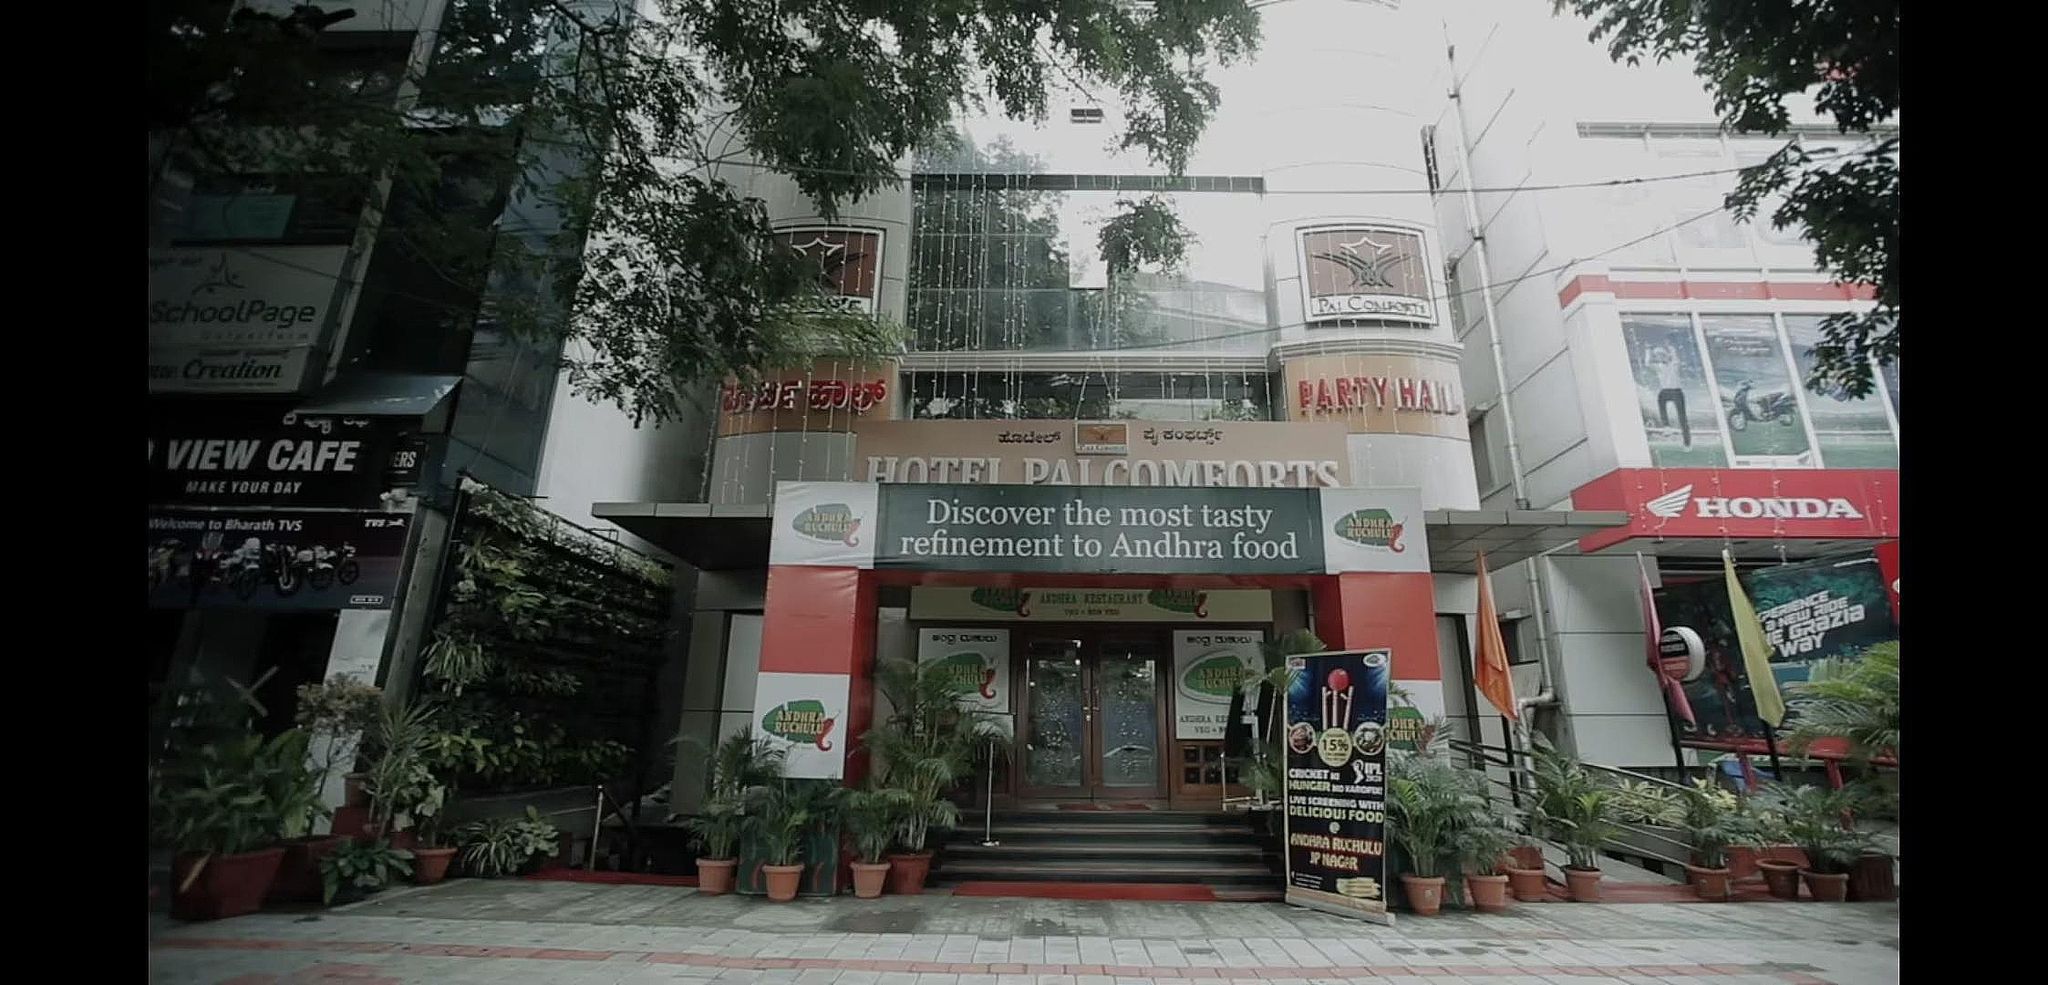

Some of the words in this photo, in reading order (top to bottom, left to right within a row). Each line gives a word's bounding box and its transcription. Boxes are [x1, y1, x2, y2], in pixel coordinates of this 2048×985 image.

[151, 299, 316, 329] SchoolPage
[183, 358, 282, 379] Creation
[1298, 376, 1389, 413] PARTY
[1395, 378, 1461, 415] HALL
[166, 438, 263, 471] VIEW
[266, 438, 361, 472] CAFE
[1104, 458, 1342, 488] COMFORTS
[184, 481, 226, 494] MAKE
[231, 481, 270, 494] YOUR
[273, 482, 303, 494] DAY
[926, 499, 1056, 526] Discover
[1063, 500, 1111, 527] the
[1120, 504, 1193, 528] most
[1200, 503, 1273, 535] tasty
[1693, 497, 1863, 519] HONDA
[149, 517, 206, 531] Welcome
[208, 518, 223, 531] to
[225, 518, 275, 531] Bharath
[277, 518, 304, 532] TVS
[900, 529, 1070, 558] refinement
[1073, 533, 1101, 558] to
[1110, 532, 1223, 559] Andhra
[1230, 531, 1299, 559] food
[1758, 589, 1830, 622] PERIENCE
[776, 709, 825, 723] ANDHRA
[774, 720, 825, 735] RUCHULU
[1322, 738, 1349, 752] 15%
[1288, 767, 1330, 780] CRICKET
[1363, 762, 1383, 775] IPL
[1288, 778, 1331, 793] HUNGER
[1289, 794, 1308, 805] LIVE
[1308, 796, 1358, 809] SCREENING
[1358, 799, 1384, 811] WITH
[1289, 804, 1347, 821] DELICIOUS
[1348, 809, 1385, 824] FOOD
[1290, 832, 1330, 849] ANDHRA
[1331, 836, 1384, 856] RUCHULU
[1321, 853, 1359, 871] NAGAR
